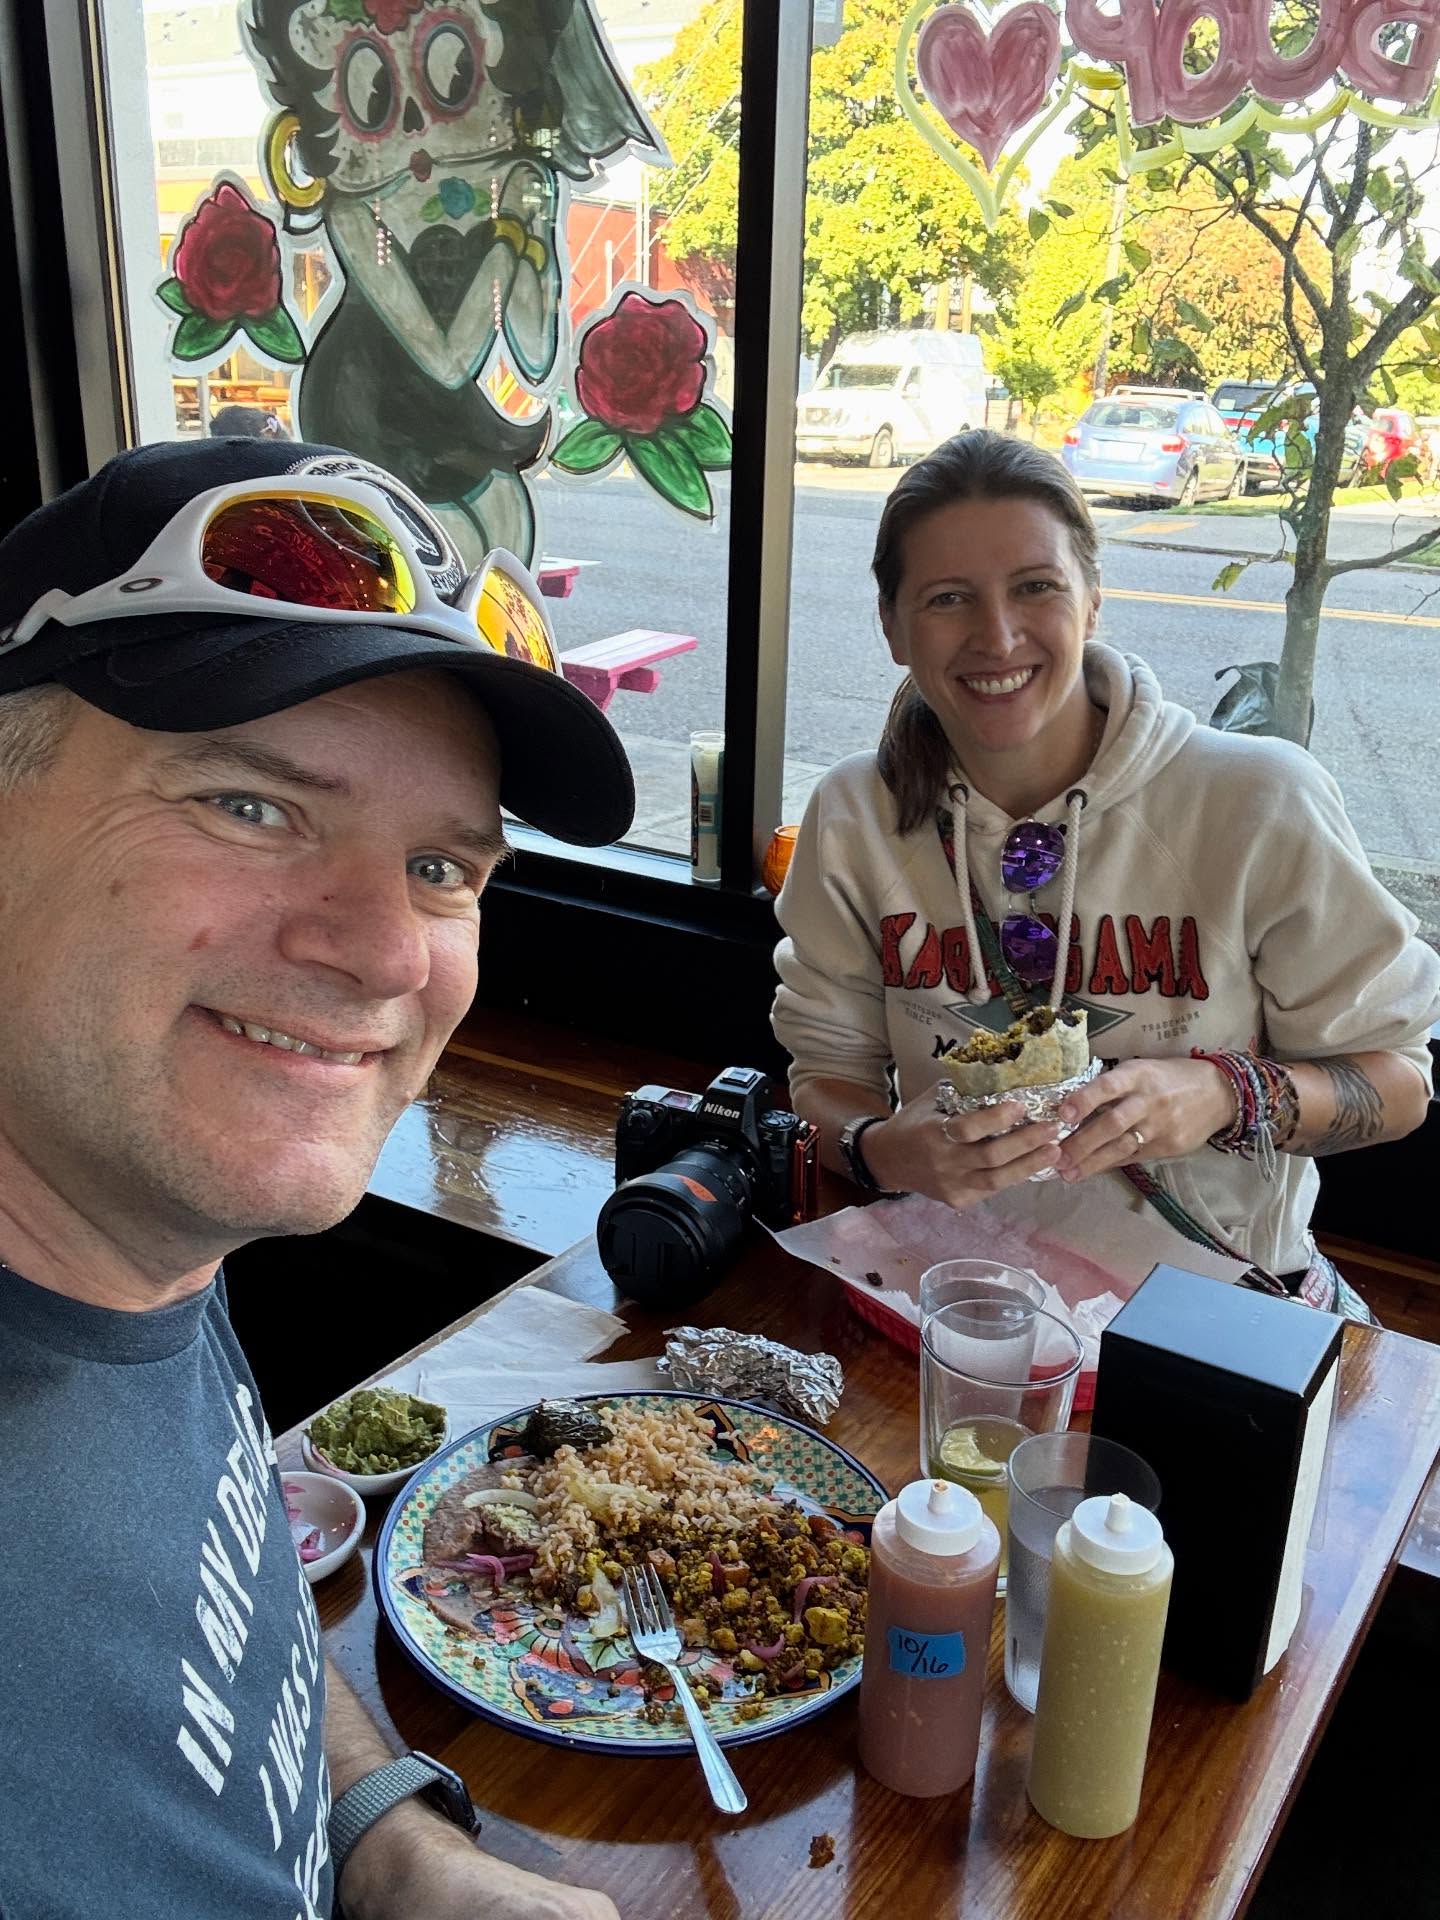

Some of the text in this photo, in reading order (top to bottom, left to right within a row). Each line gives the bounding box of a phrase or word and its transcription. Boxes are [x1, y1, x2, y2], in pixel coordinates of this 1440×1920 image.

[704, 1101, 741, 1119] Nikon
[195, 1518, 254, 1685] MY
[898, 1633, 950, 1674] 10/16
[175, 1658, 236, 1797] IN
[267, 1642, 311, 1816] WAS
[258, 1763, 283, 1853] I
